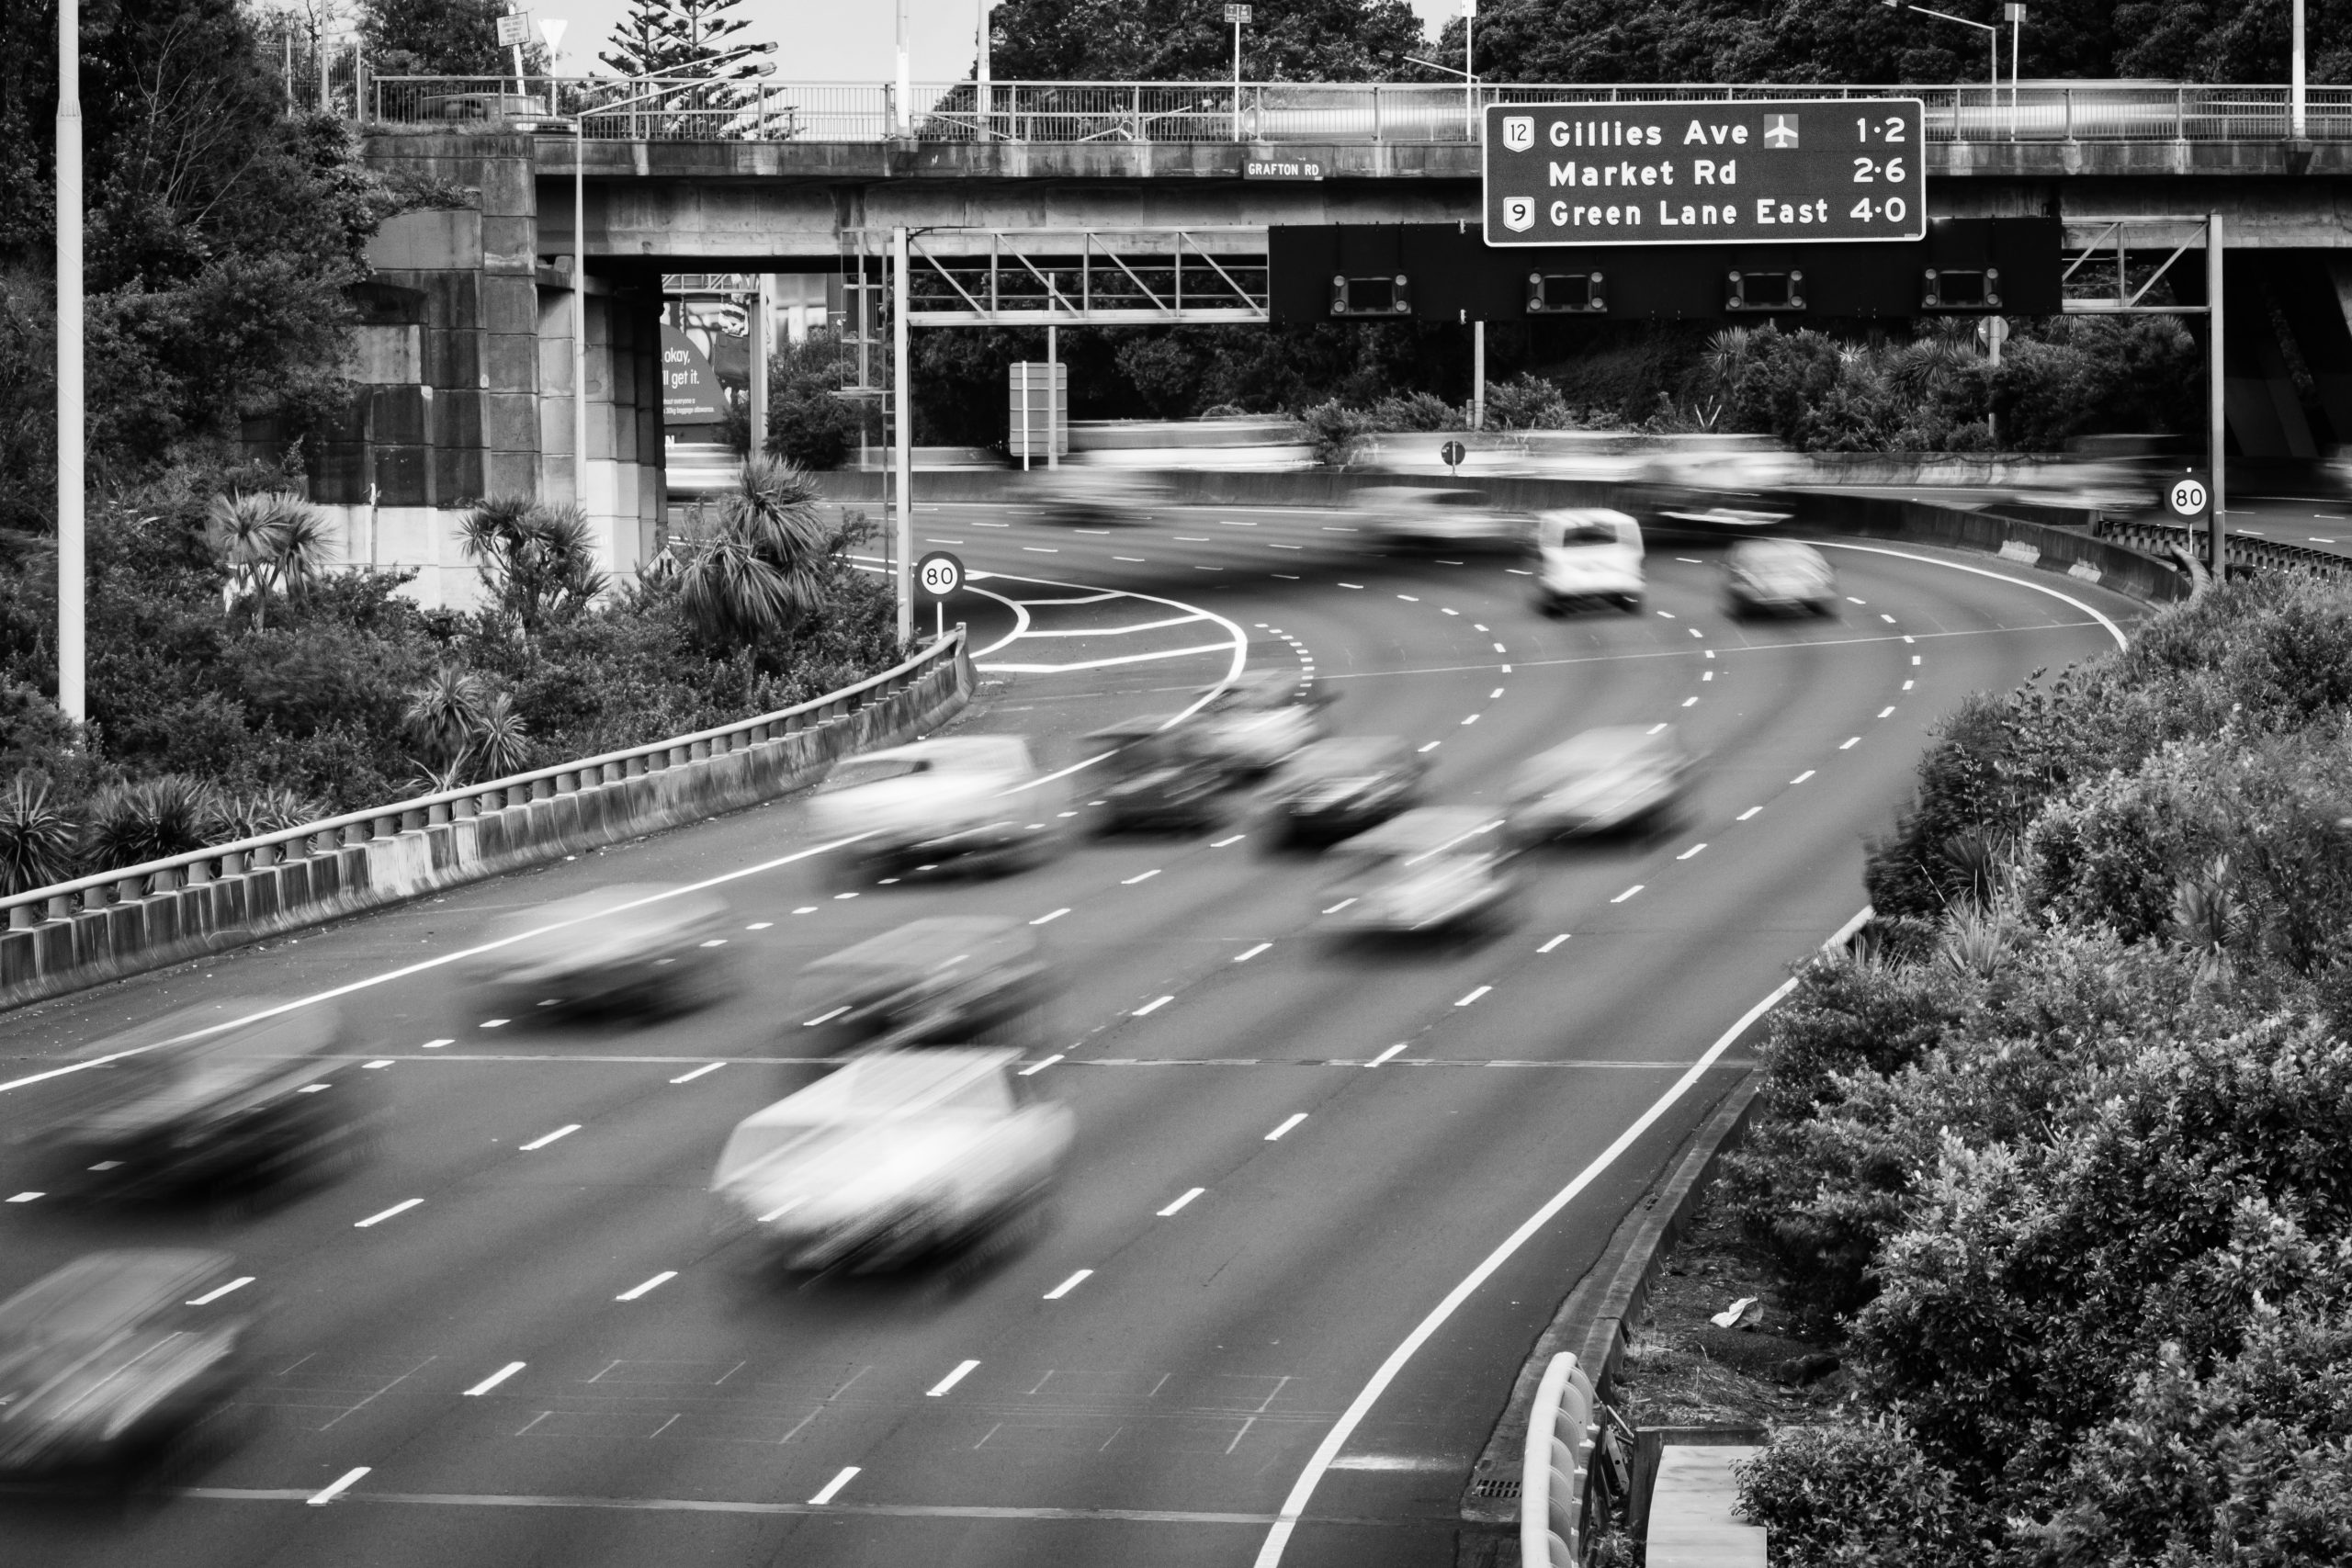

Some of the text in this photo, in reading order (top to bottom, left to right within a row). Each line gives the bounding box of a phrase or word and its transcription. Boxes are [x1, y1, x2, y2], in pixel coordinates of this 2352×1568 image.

[1510, 123, 1528, 141] 12
[1549, 120, 1662, 147] Gillies
[1683, 120, 1748, 145] Ave
[1248, 163, 1319, 176] GRAFTON RD
[1549, 160, 1674, 186] Market
[1694, 159, 1736, 185] Rd
[1512, 204, 1526, 221] 9
[1550, 200, 1641, 227] Green
[1659, 199, 1737, 226] Lane
[1757, 198, 1828, 224] East
[664, 346, 691, 366] okay,
[672, 370, 689, 389] get
[690, 368, 700, 385] it.
[2176, 488, 2203, 507] 80
[926, 567, 954, 586] 80
